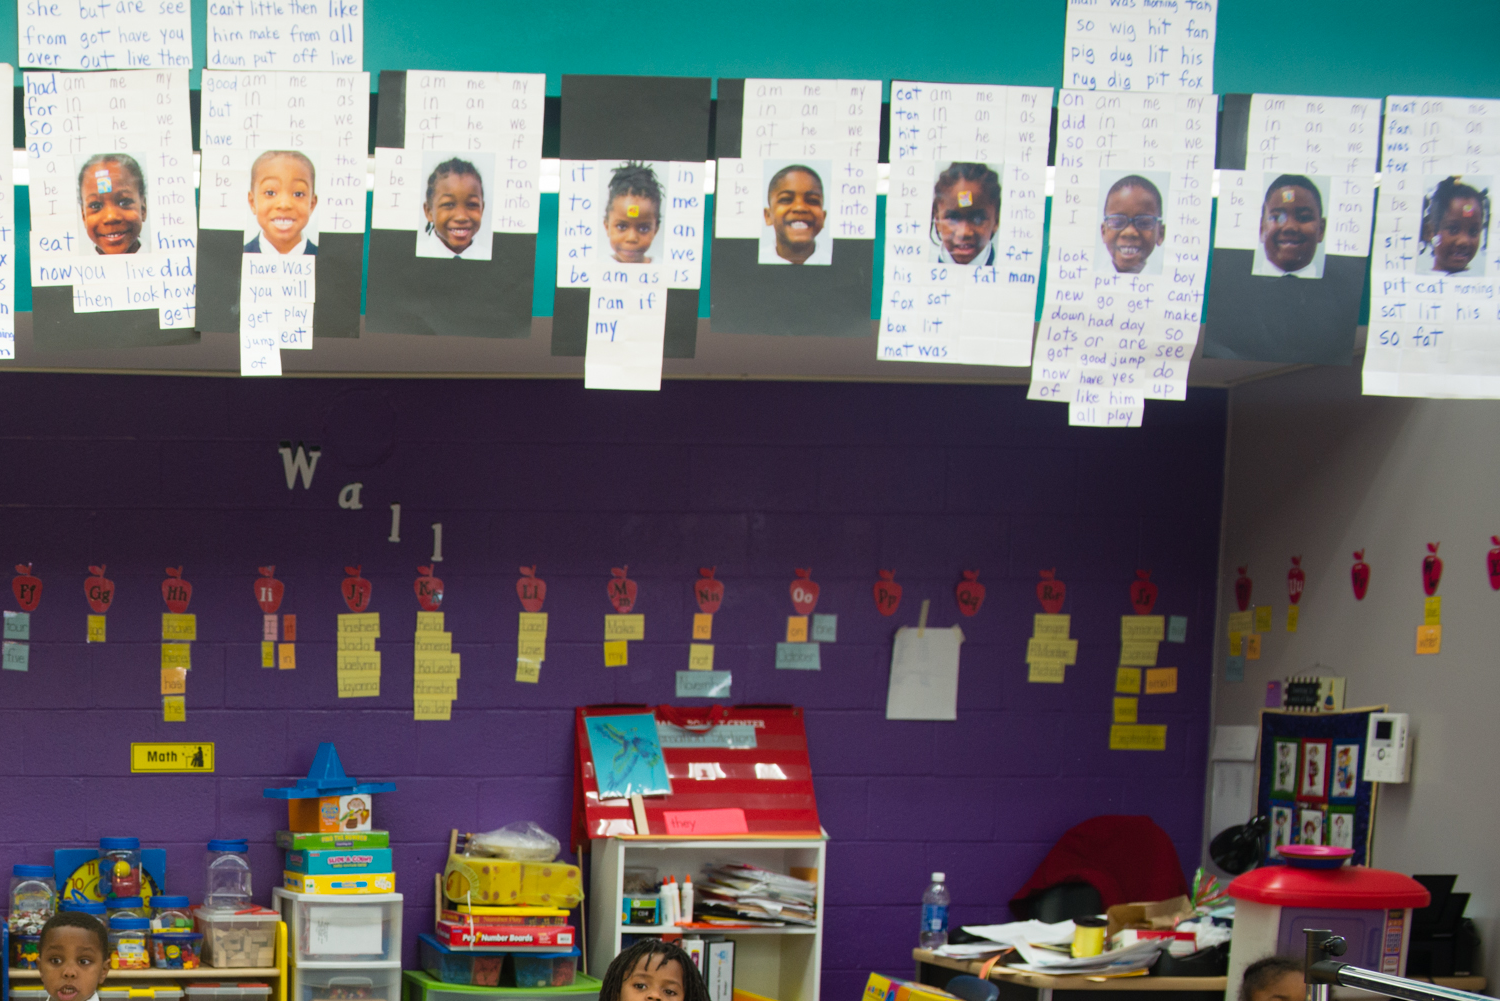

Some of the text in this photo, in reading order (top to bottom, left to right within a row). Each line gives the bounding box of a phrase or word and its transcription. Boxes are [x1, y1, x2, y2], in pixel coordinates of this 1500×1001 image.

[1076, 17, 1209, 41] so wig hit fan
[24, 27, 184, 52] from got have you
[211, 49, 356, 68] down put off live
[1071, 46, 1203, 66] pig dug lit his
[26, 74, 58, 94] had
[1072, 70, 1204, 91] rug dig pit fox
[38, 232, 195, 252] eat him
[39, 261, 192, 283] now you live did
[570, 266, 589, 283] be
[602, 270, 628, 283] am
[638, 271, 659, 284] as
[972, 266, 1036, 284] fat man
[164, 304, 195, 326] get
[595, 319, 618, 342] my
[1379, 328, 1444, 347] so fat
[20, 584, 36, 605] Ff
[89, 585, 110, 604] Gg
[167, 586, 188, 602] Hh
[260, 587, 274, 602] Ii
[347, 584, 364, 608] Jj
[610, 581, 630, 607] Mm
[699, 589, 720, 605] Nn
[793, 587, 814, 604] Oo
[879, 588, 897, 609] Pp
[7, 648, 25, 663] five
[147, 748, 178, 763] Math
[671, 815, 697, 832] they
[86, 863, 95, 876] 11
[71, 878, 84, 890] 10
[481, 934, 509, 943] Number
[509, 934, 533, 943] Boards
